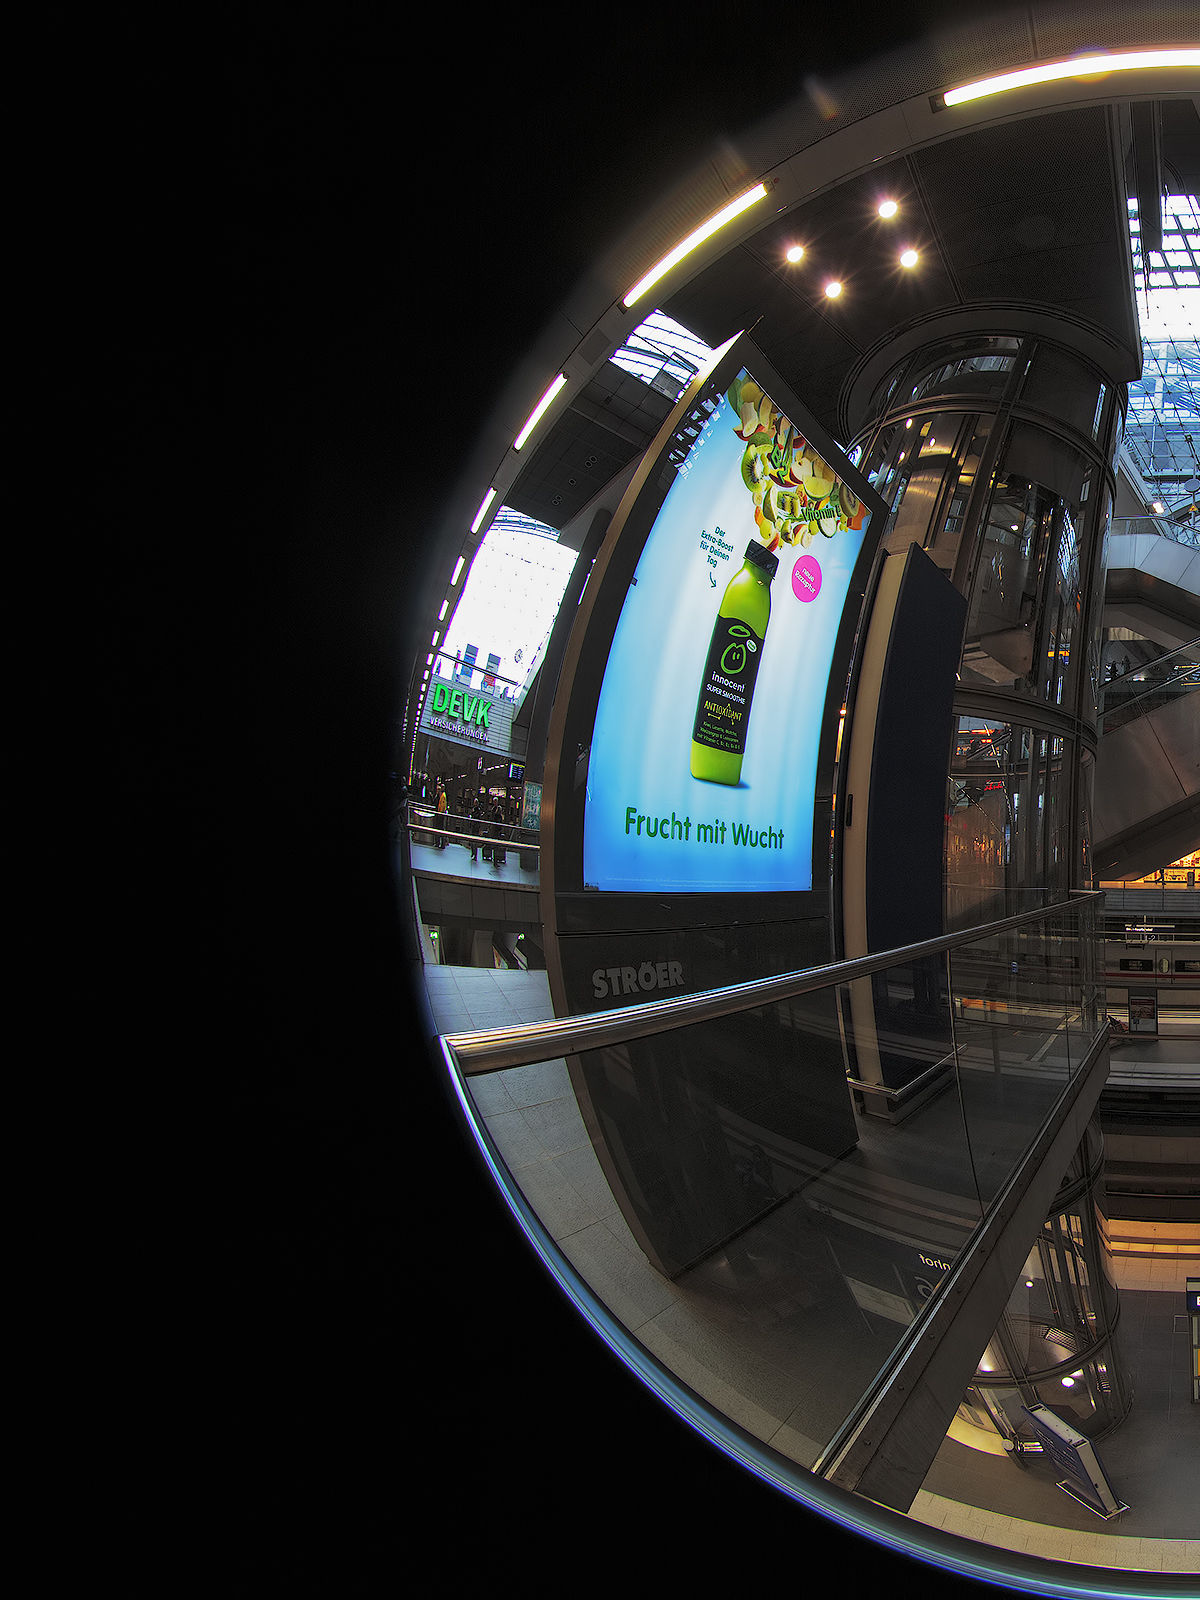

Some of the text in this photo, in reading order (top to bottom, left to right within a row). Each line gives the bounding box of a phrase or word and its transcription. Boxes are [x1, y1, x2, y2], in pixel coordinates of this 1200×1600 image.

[700, 530, 733, 552] Extra-Boost
[715, 526, 726, 537] Der
[699, 540, 729, 561] für Deinen
[707, 554, 718, 568] Tag
[711, 670, 745, 693] innocent
[706, 683, 746, 705] SUPER SMOOTHIE
[432, 683, 492, 728] DEVK
[703, 700, 743, 721] ANTIOXIDANT
[430, 716, 489, 741] VERSICHERUNGEN
[625, 806, 785, 849] Frucht mit Wucht
[592, 960, 686, 999] STRÖER
